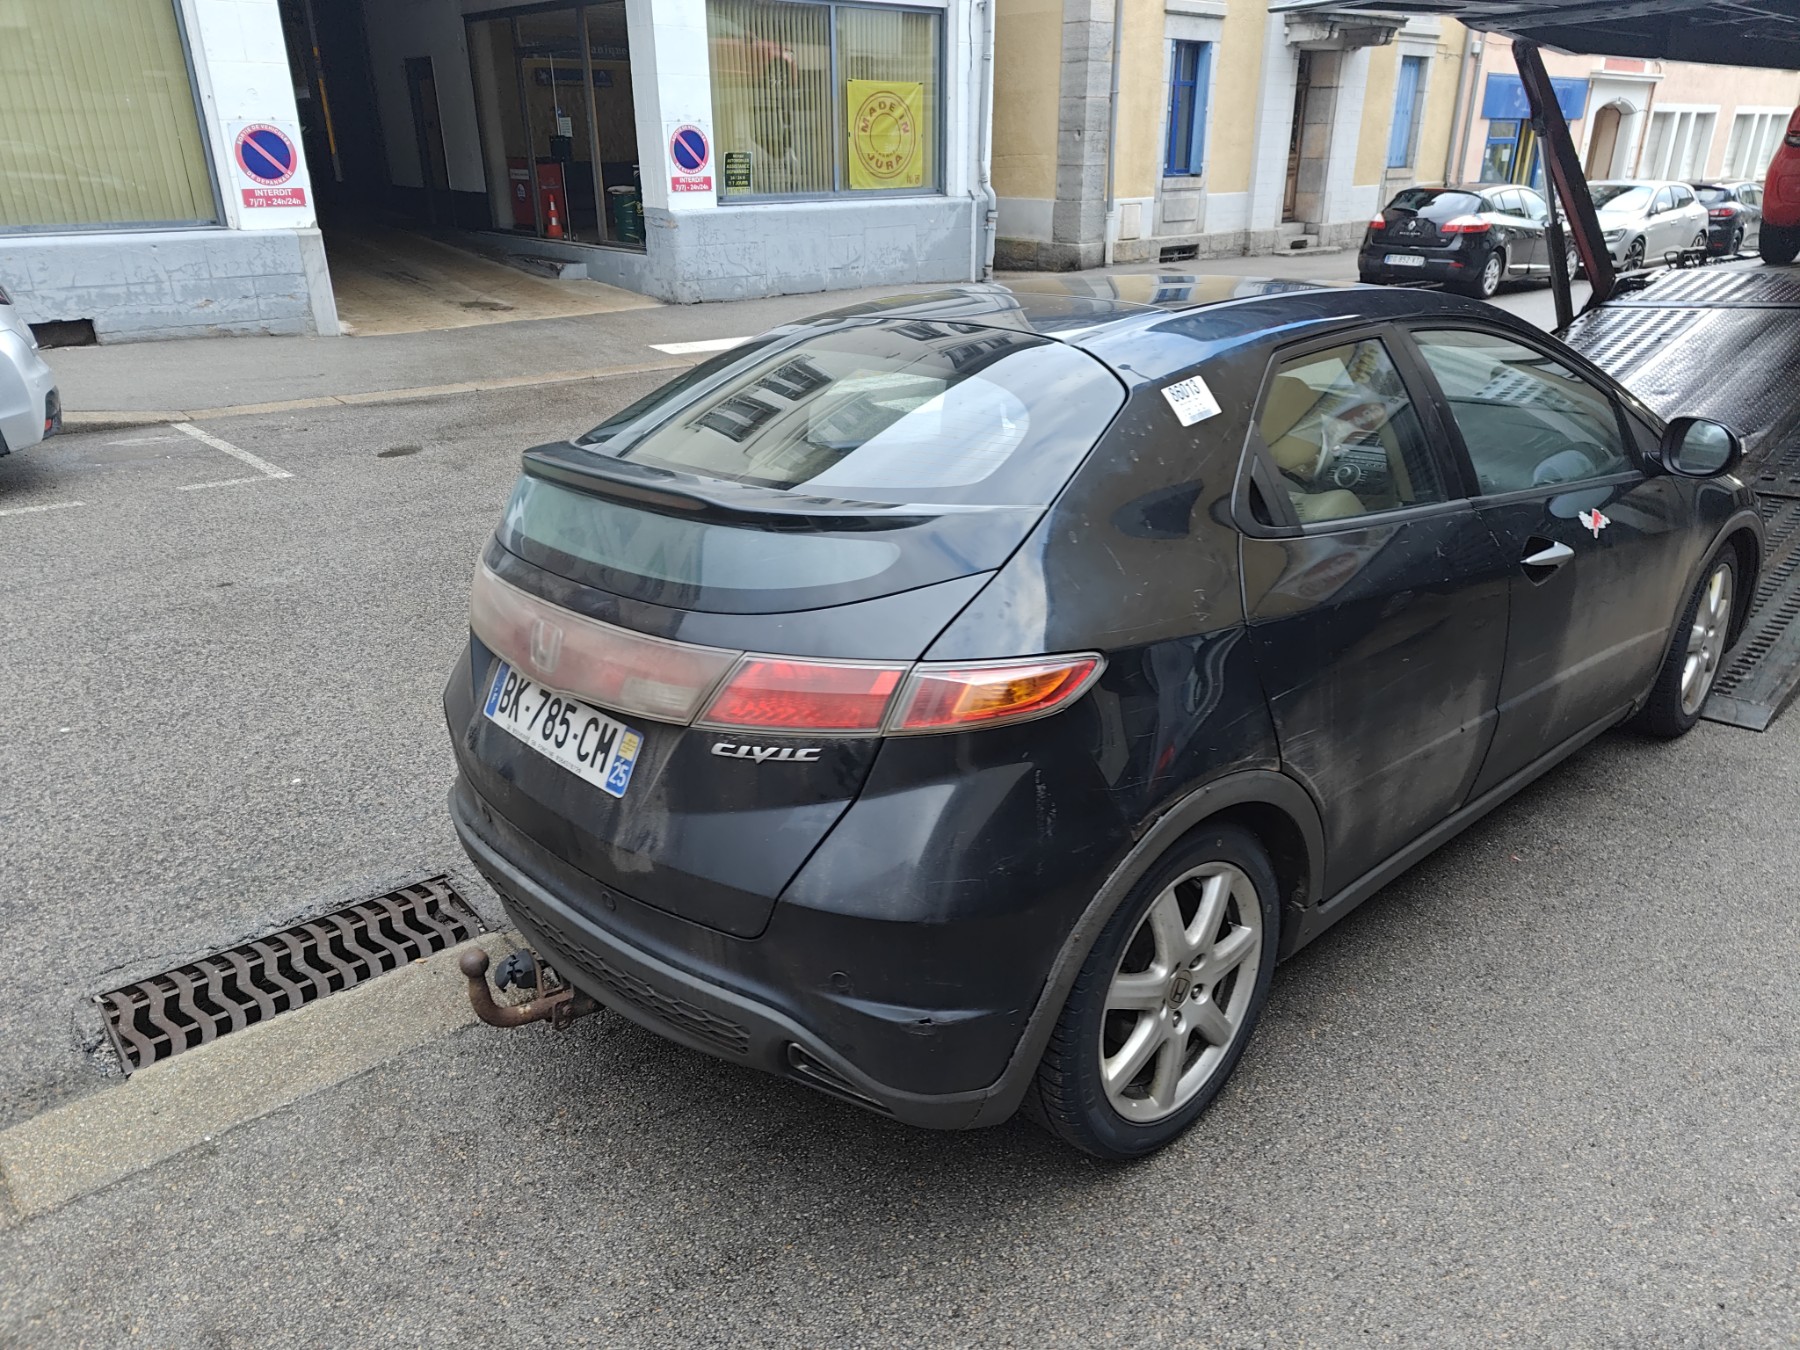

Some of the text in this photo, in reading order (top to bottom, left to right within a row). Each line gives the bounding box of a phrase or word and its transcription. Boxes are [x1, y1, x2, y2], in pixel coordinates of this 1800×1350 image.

[861, 101, 910, 134] MADE IN
[237, 127, 251, 144] SORTIE
[867, 152, 903, 171] JURA
[246, 171, 256, 179] DE
[254, 188, 293, 197] INTERDIT
[272, 198, 301, 206] 24h/24h
[498, 671, 618, 773] BK-785-CM
[608, 761, 629, 787] 25
[710, 742, 822, 765] CIVIC
